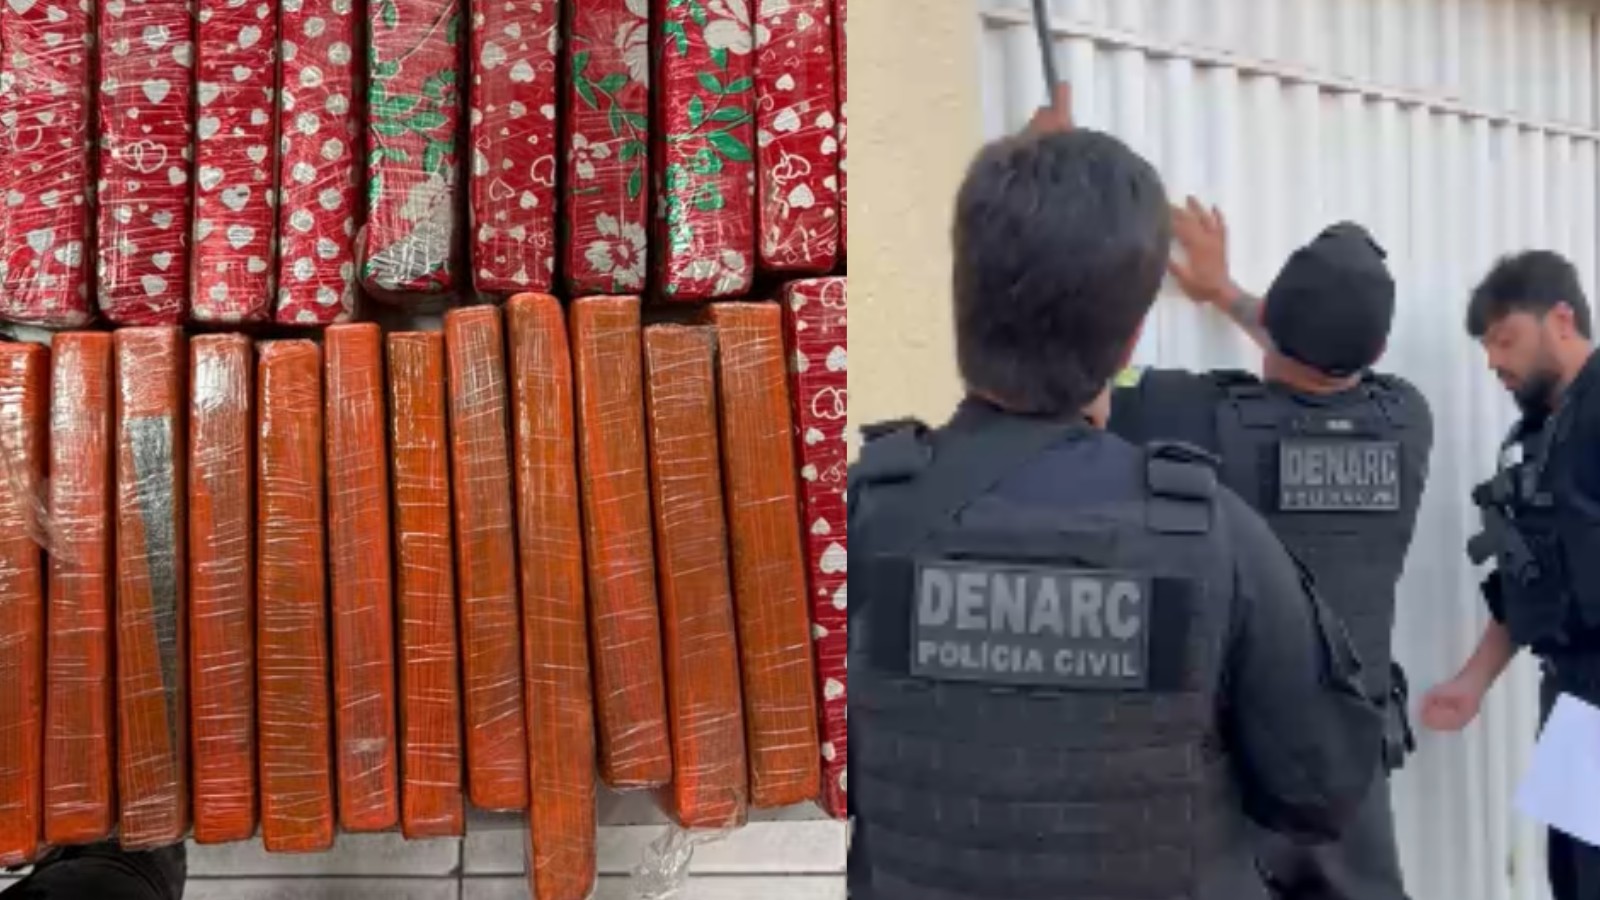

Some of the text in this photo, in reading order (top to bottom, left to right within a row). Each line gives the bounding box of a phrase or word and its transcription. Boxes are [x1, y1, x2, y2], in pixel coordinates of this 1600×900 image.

[1284, 448, 1396, 486] DENARC
[918, 568, 1141, 640] DENARC
[1053, 649, 1138, 677] CIVIL
